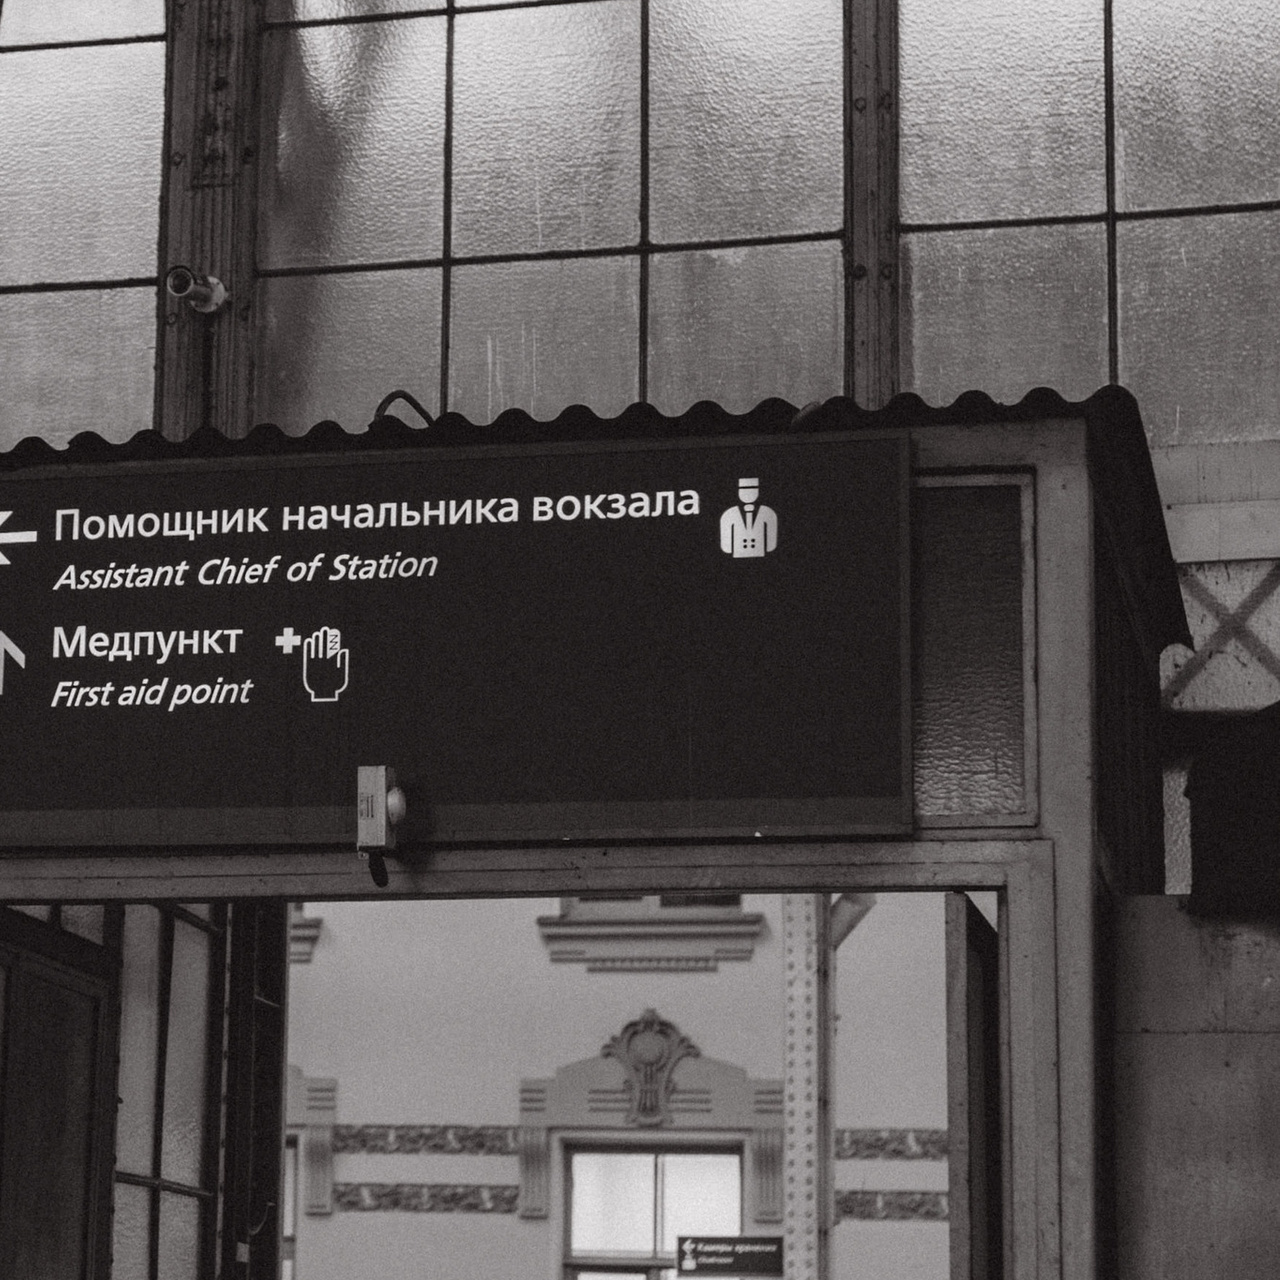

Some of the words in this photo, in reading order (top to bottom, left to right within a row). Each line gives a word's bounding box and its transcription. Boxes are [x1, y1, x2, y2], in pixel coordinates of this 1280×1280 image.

[54, 506, 269, 542] Помощник
[281, 497, 520, 532] начальника
[532, 489, 701, 522] вокзала
[52, 560, 191, 591] Assistant
[197, 554, 282, 586] Chief
[286, 552, 326, 583] of
[328, 550, 439, 582] Station
[52, 624, 244, 665] Медпункт
[50, 679, 116, 708] First
[117, 676, 170, 707] aid
[167, 676, 255, 713] point
